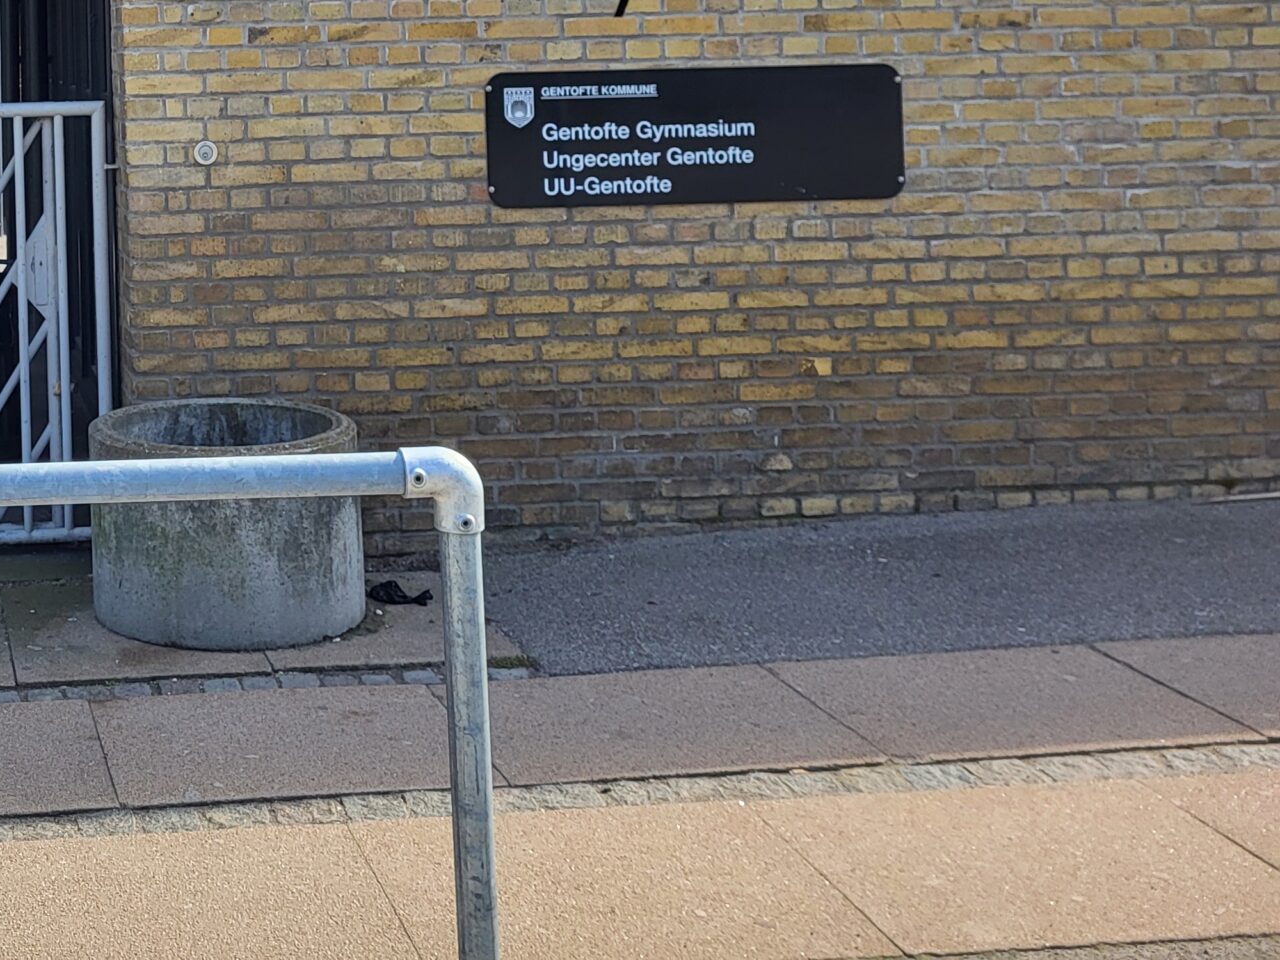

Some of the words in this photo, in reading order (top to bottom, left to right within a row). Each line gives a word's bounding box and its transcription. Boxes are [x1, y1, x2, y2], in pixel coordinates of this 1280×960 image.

[540, 85, 599, 97] GENTOFTE
[601, 84, 657, 95] KOMMUNE
[541, 121, 630, 141] Gentofte
[635, 118, 756, 142] Gymnasium
[542, 149, 660, 172] Ungecenter
[666, 146, 754, 166] Gentofte
[543, 176, 673, 196] UU-Gentofte
